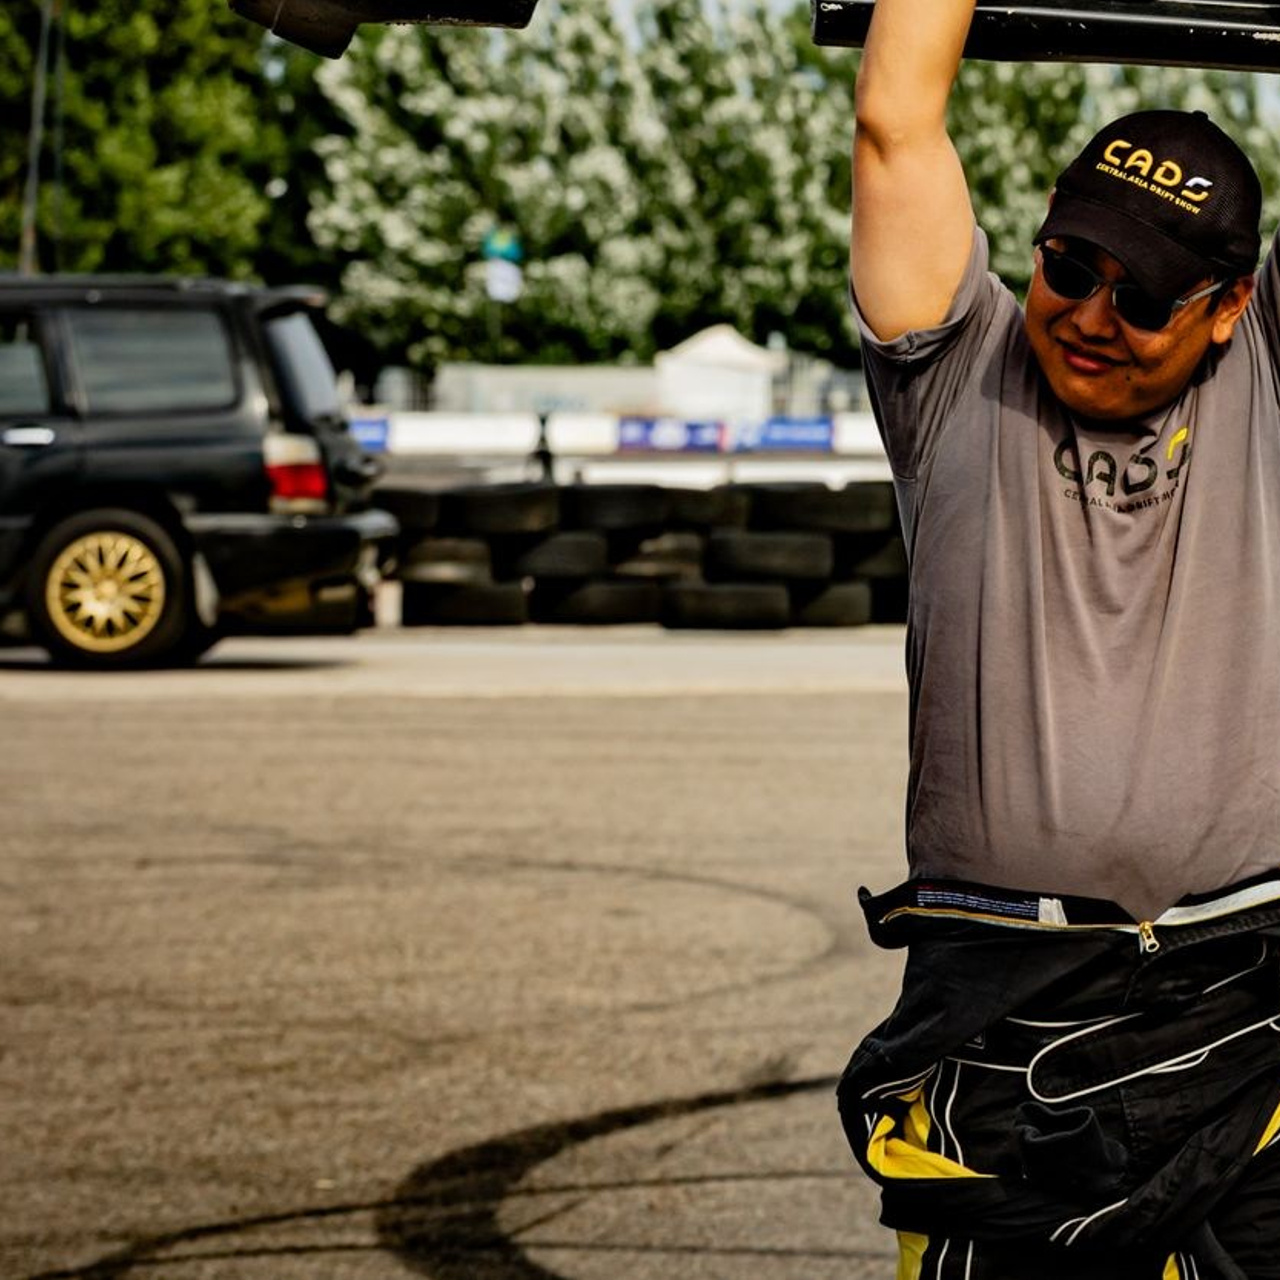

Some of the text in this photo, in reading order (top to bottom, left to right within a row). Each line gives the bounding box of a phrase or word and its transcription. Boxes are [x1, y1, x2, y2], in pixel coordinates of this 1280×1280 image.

[1103, 139, 1213, 202] CADS
[1127, 174, 1148, 190] ASIA
[1149, 183, 1175, 202] DRIFT
